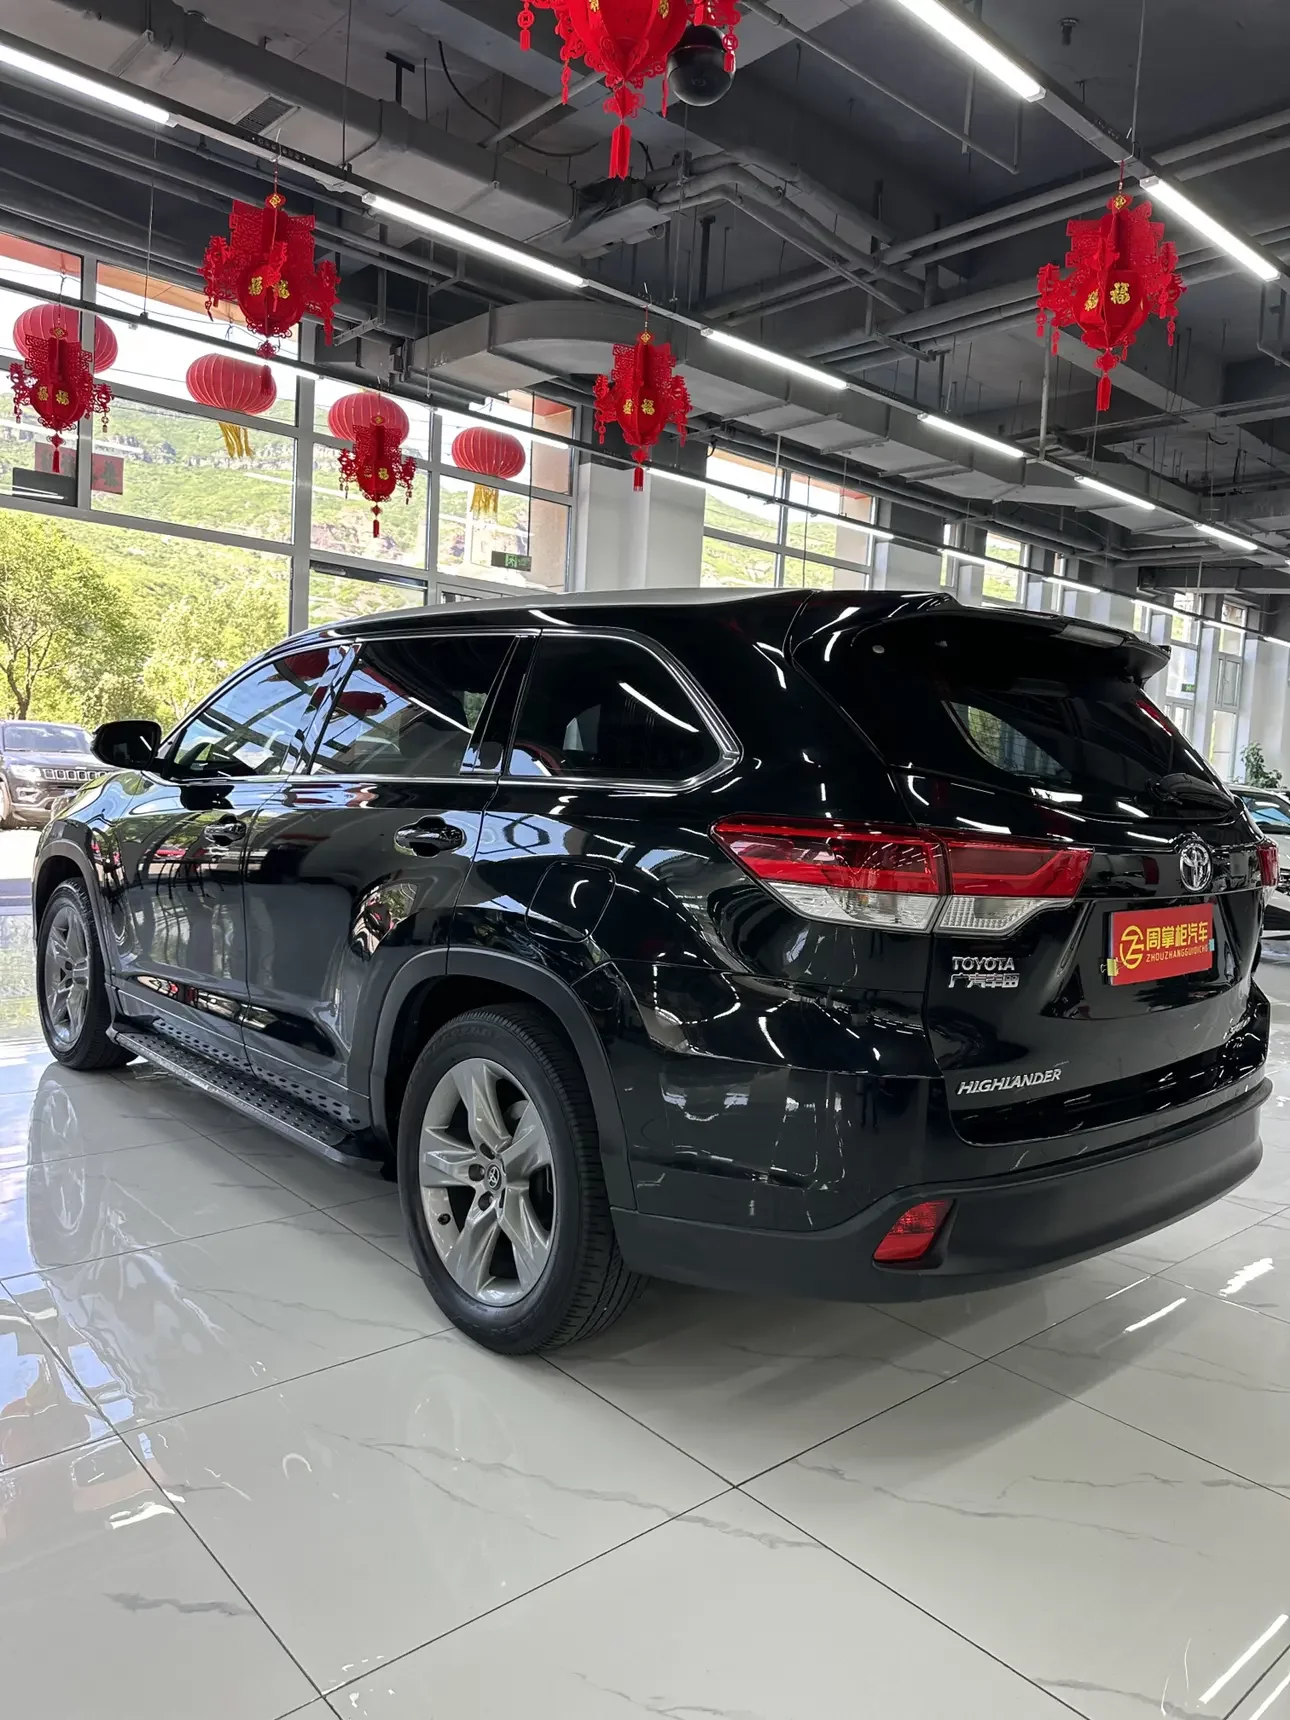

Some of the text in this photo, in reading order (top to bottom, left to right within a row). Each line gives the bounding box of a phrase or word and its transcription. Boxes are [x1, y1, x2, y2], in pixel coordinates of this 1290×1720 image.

[1146, 921, 1209, 951] 周掌柜汽车
[951, 956, 1016, 971] TOYOTA
[956, 1068, 1063, 1096] HIGHLANDER
